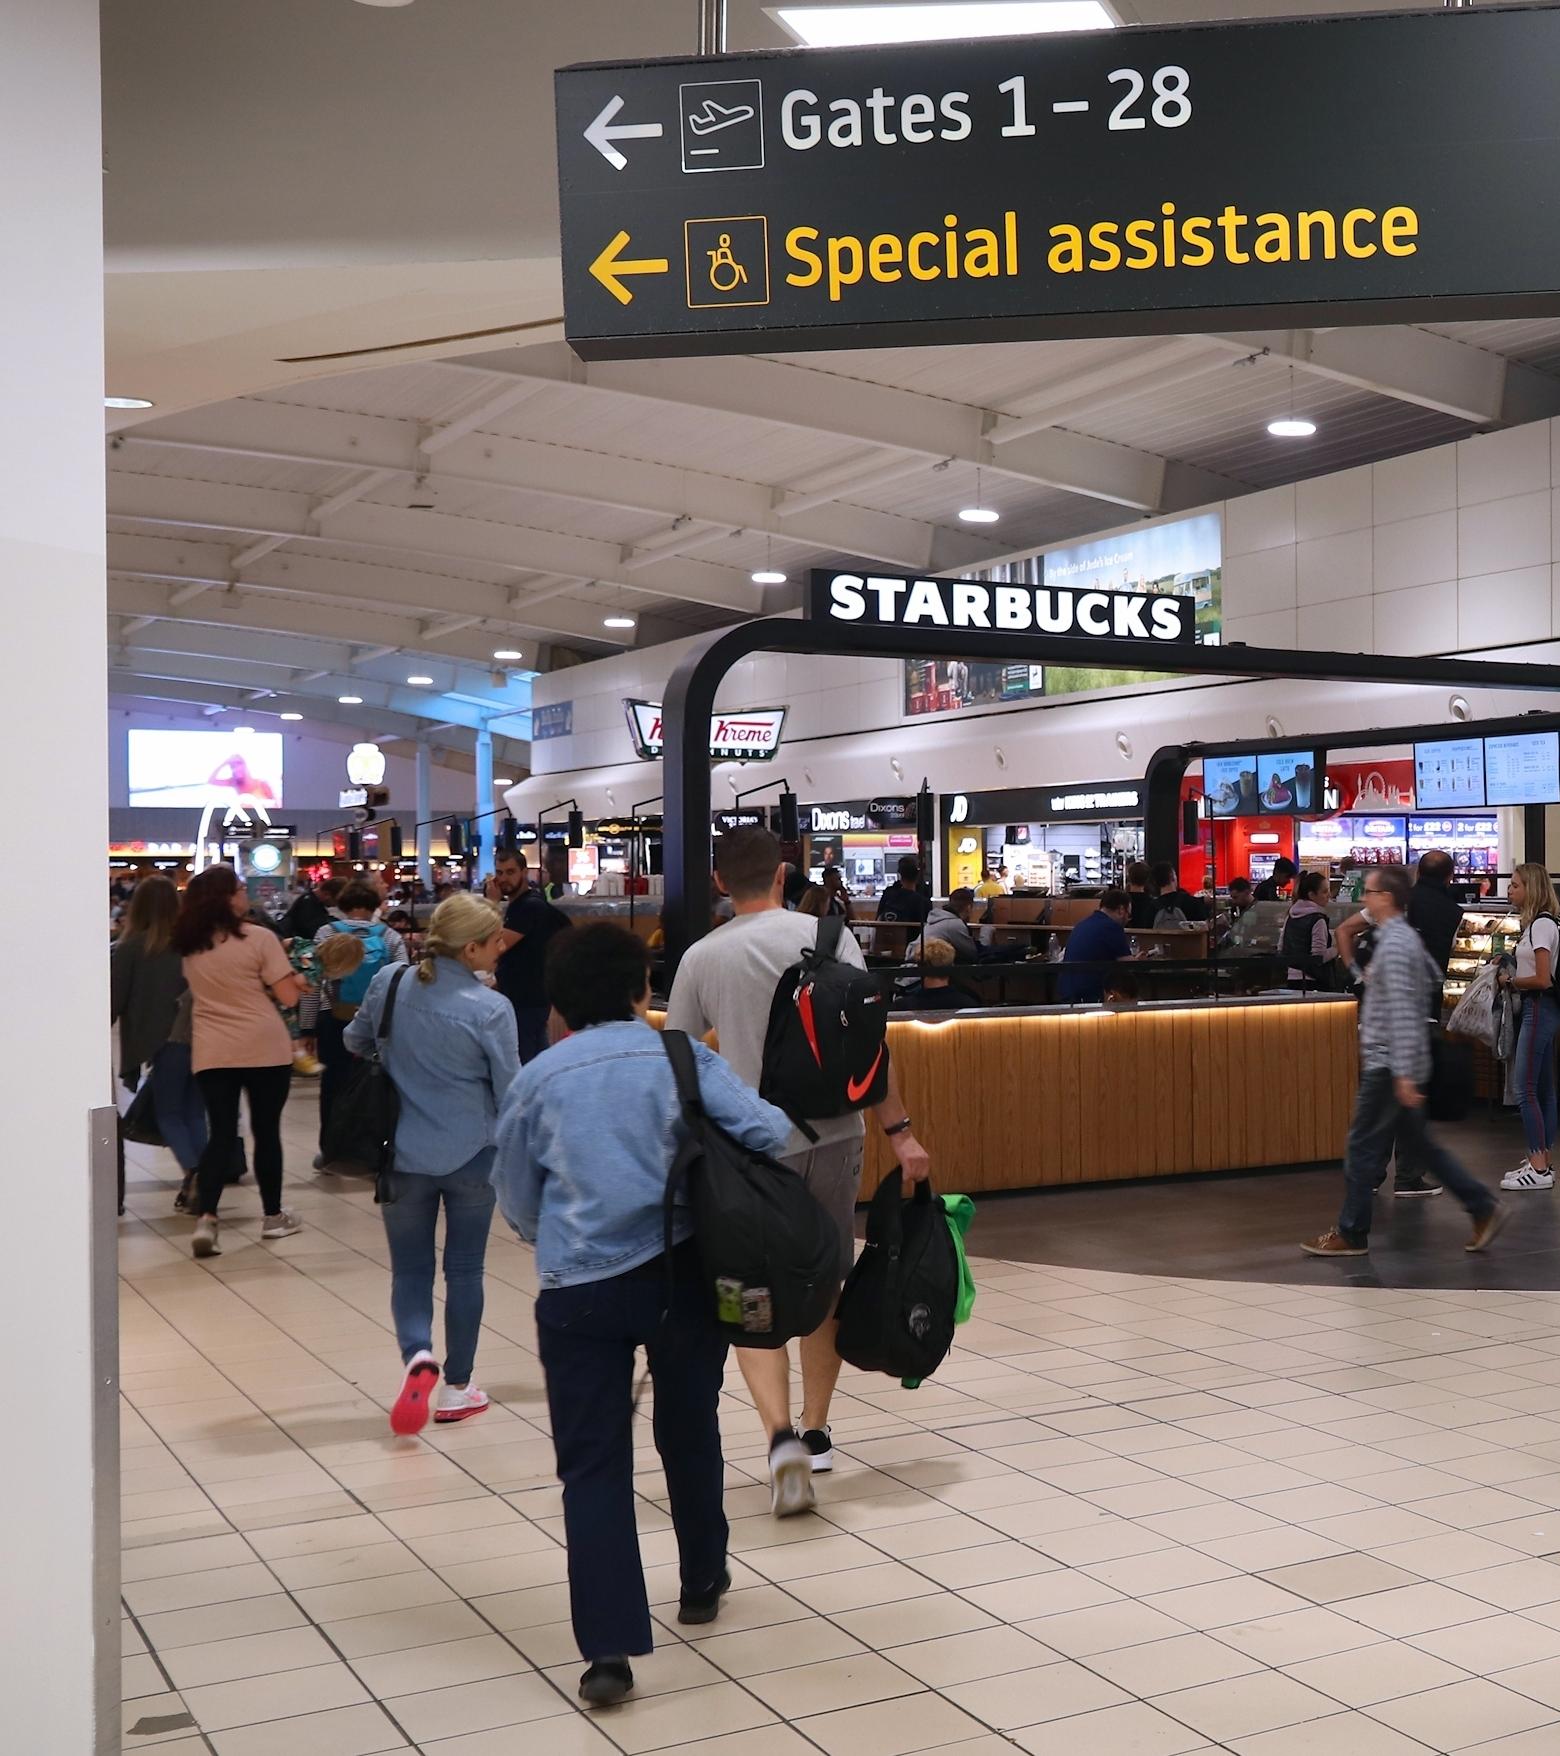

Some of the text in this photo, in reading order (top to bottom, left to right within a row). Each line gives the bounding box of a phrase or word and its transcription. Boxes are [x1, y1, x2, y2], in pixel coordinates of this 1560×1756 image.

[780, 86, 973, 152] Gates
[998, 76, 1037, 140] 1
[1107, 65, 1194, 132] 28
[783, 203, 1420, 301] Special assistance
[829, 574, 1182, 640] STARBUCKS
[713, 720, 775, 743] Kreme
[811, 807, 850, 832] Dixons
[870, 802, 905, 813] Dixons
[950, 795, 968, 822] JD
